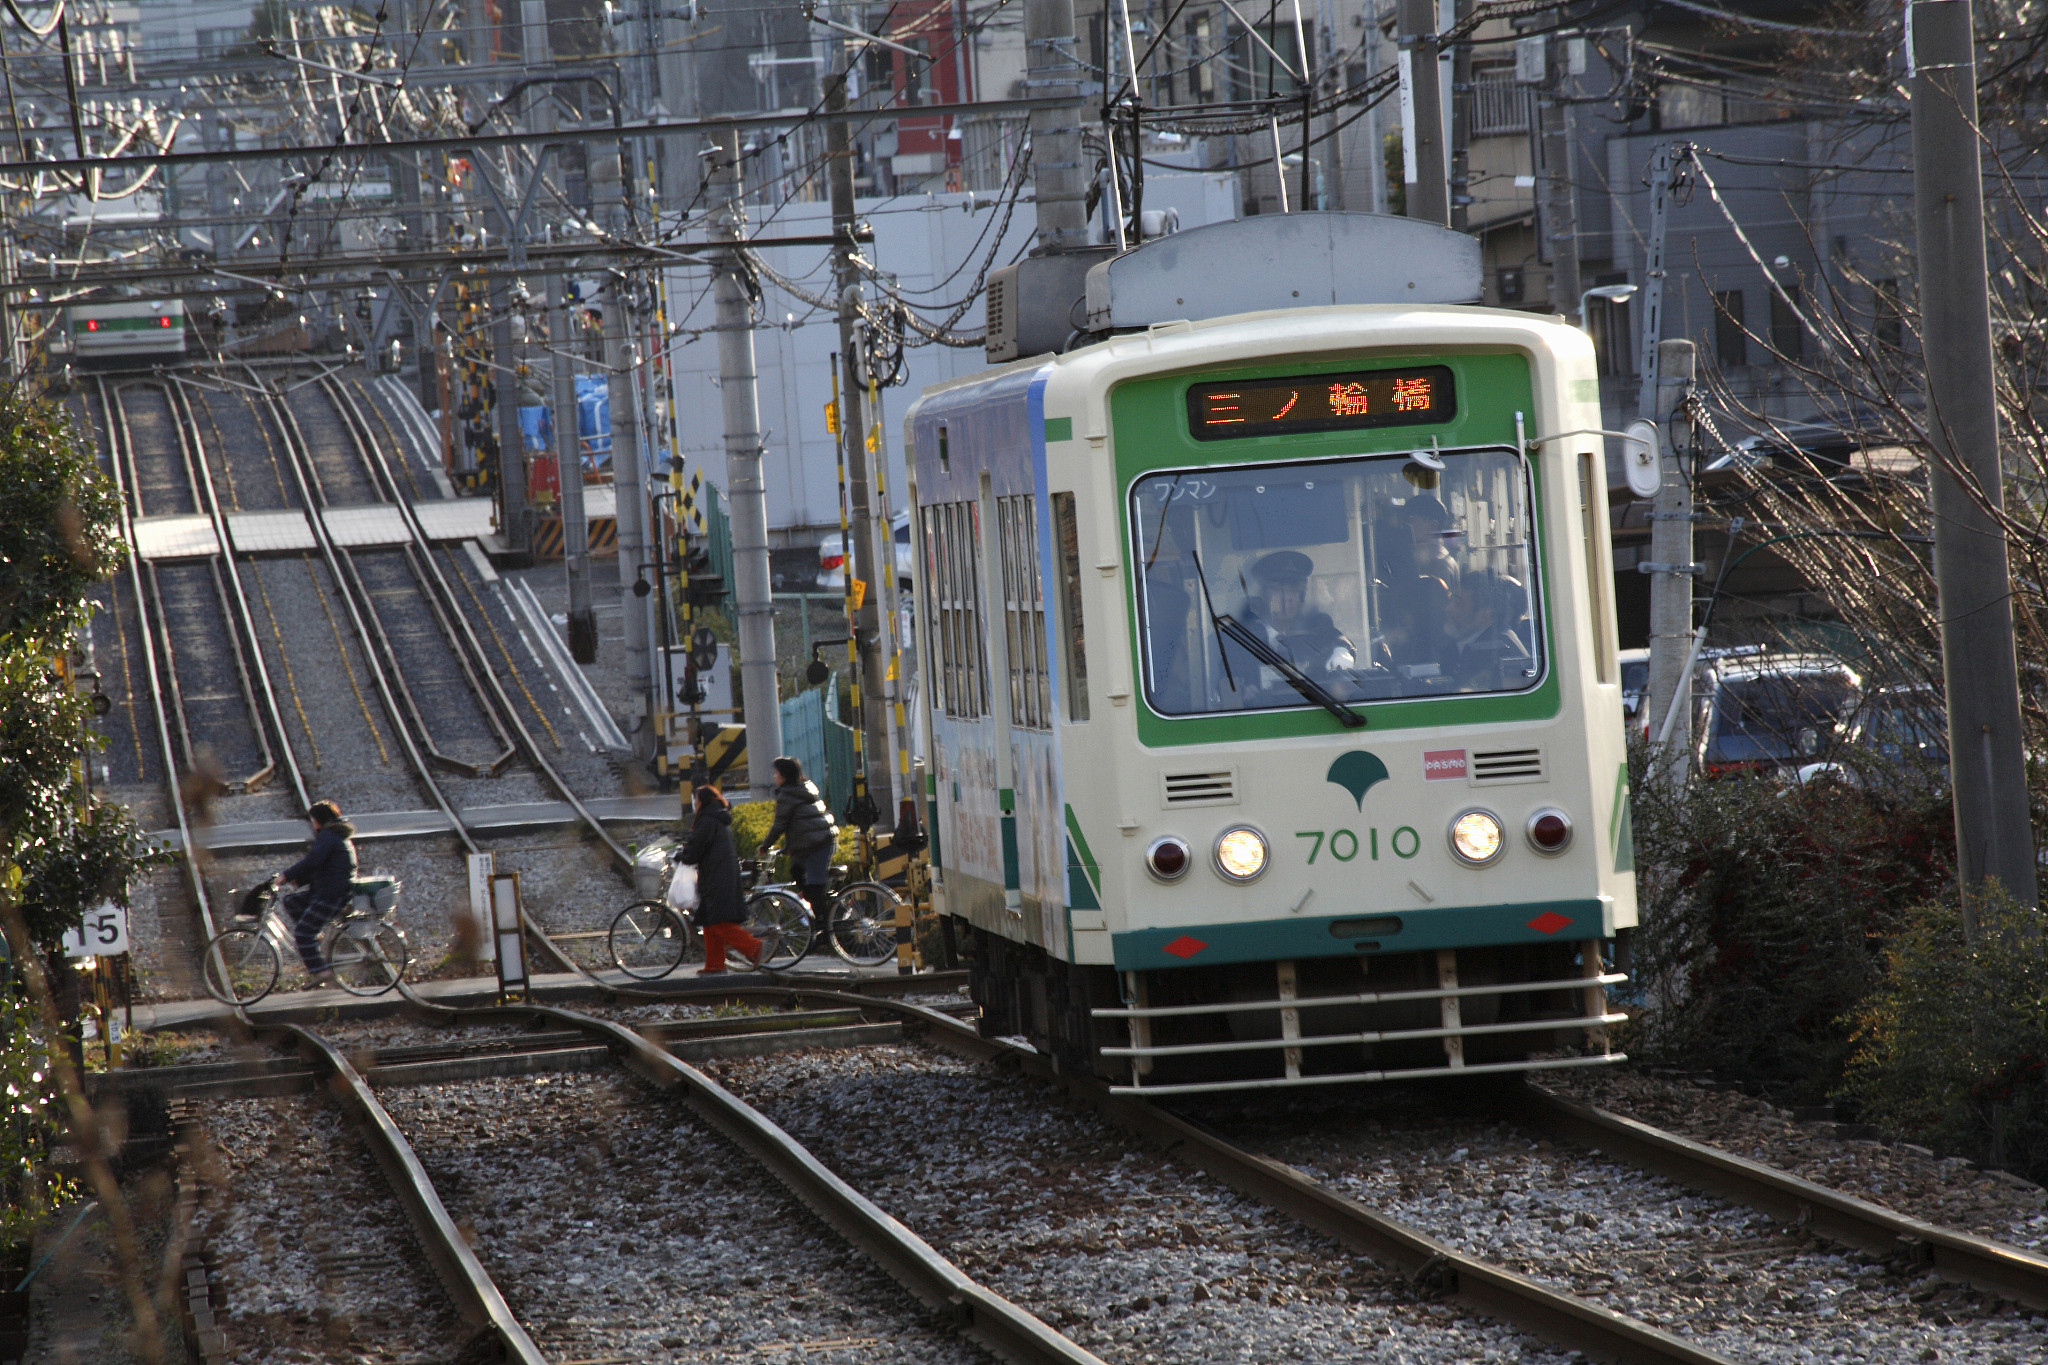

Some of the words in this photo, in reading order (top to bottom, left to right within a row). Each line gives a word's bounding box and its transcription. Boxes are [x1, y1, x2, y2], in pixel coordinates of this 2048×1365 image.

[1206, 378, 1431, 424] 三ノ輪橋
[1154, 480, 1216, 502] ワンマン
[1425, 758, 1466, 771] PASMO
[1295, 826, 1420, 865] 7010
[77, 914, 119, 946] 15
